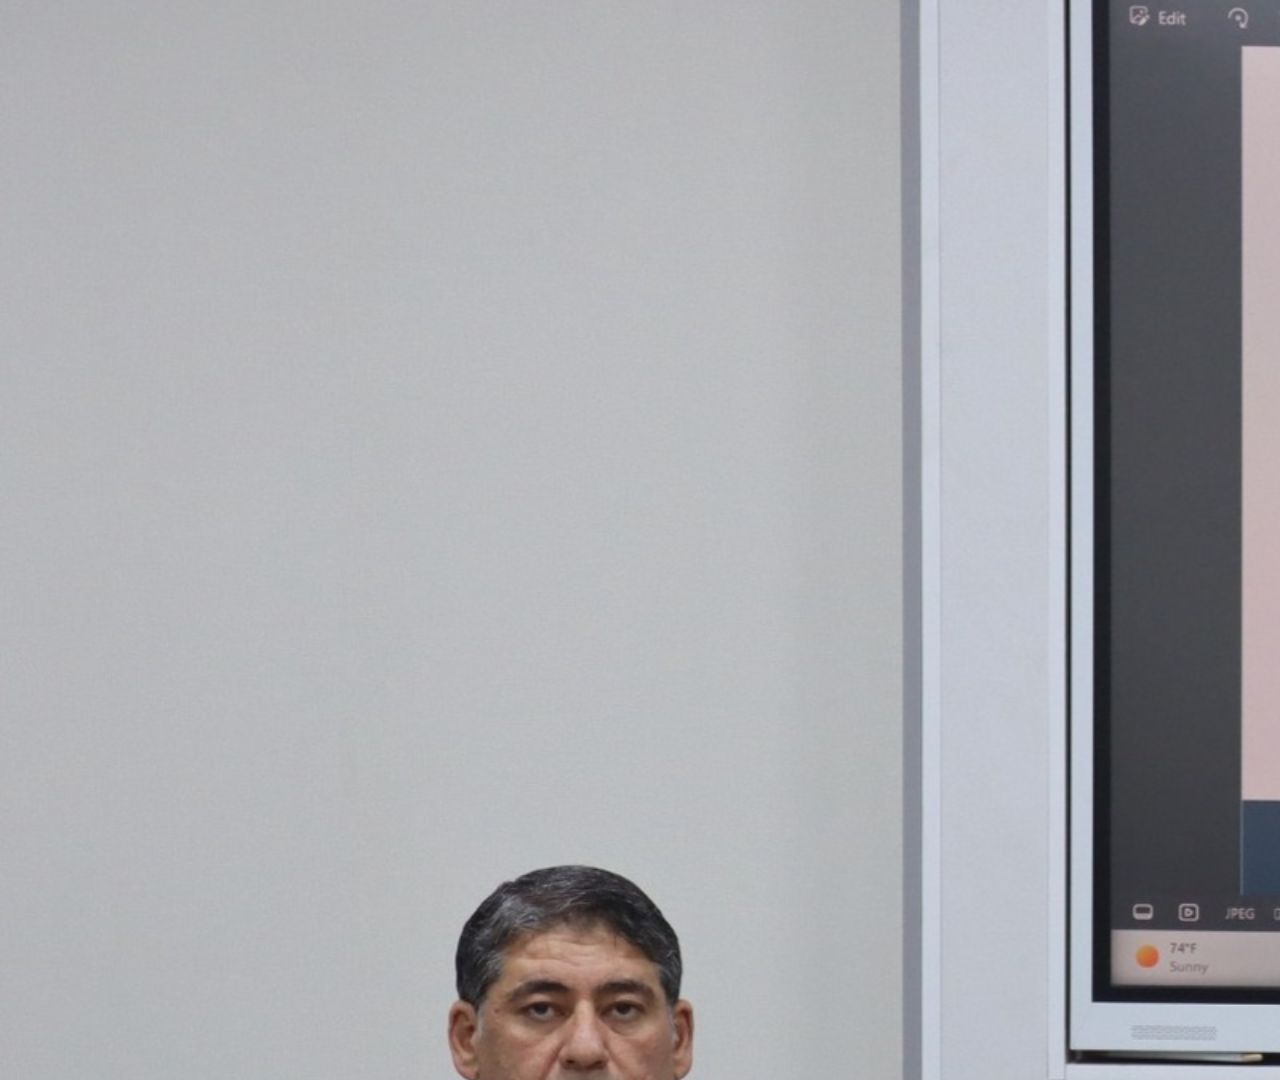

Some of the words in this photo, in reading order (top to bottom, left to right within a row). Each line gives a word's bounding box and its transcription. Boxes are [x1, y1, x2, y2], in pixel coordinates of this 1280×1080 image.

[1157, 9, 1187, 26] Edit
[1225, 908, 1256, 921] JPEG
[1169, 961, 1209, 975] Sunny
